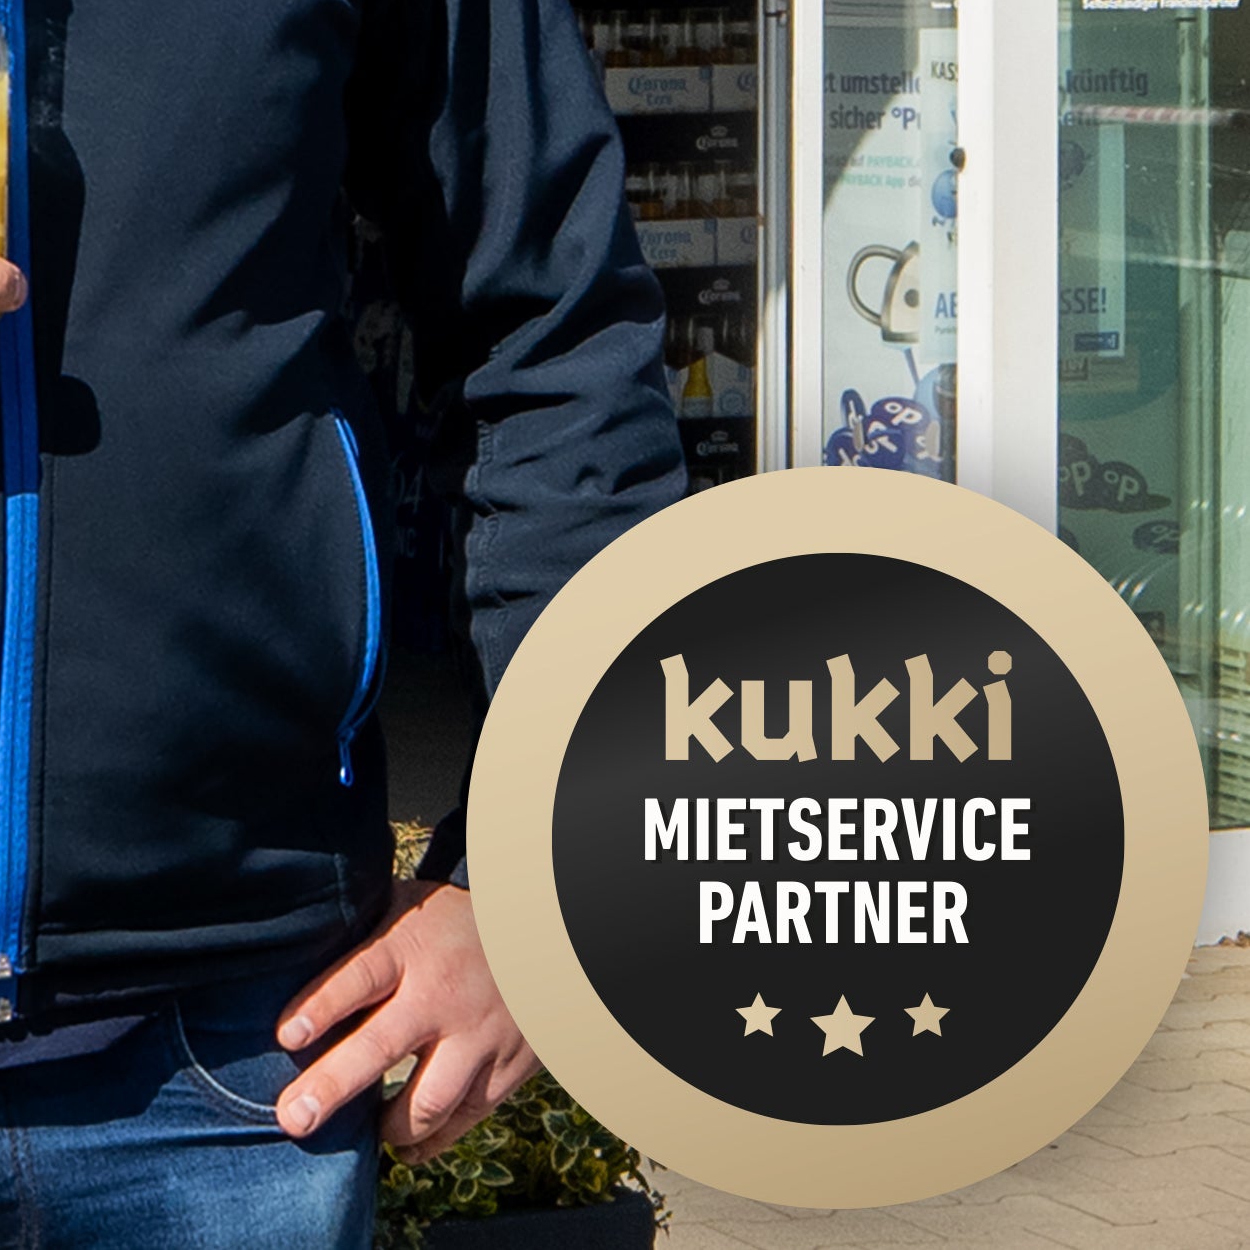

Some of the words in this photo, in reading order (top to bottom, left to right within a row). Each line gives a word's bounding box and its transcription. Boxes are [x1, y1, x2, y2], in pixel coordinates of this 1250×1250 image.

[627, 74, 689, 95] Corona
[1066, 67, 1149, 97] künftig
[830, 104, 885, 130] sicher
[695, 135, 739, 150] Corona
[698, 290, 741, 305] Corona
[696, 440, 739, 456] Corona
